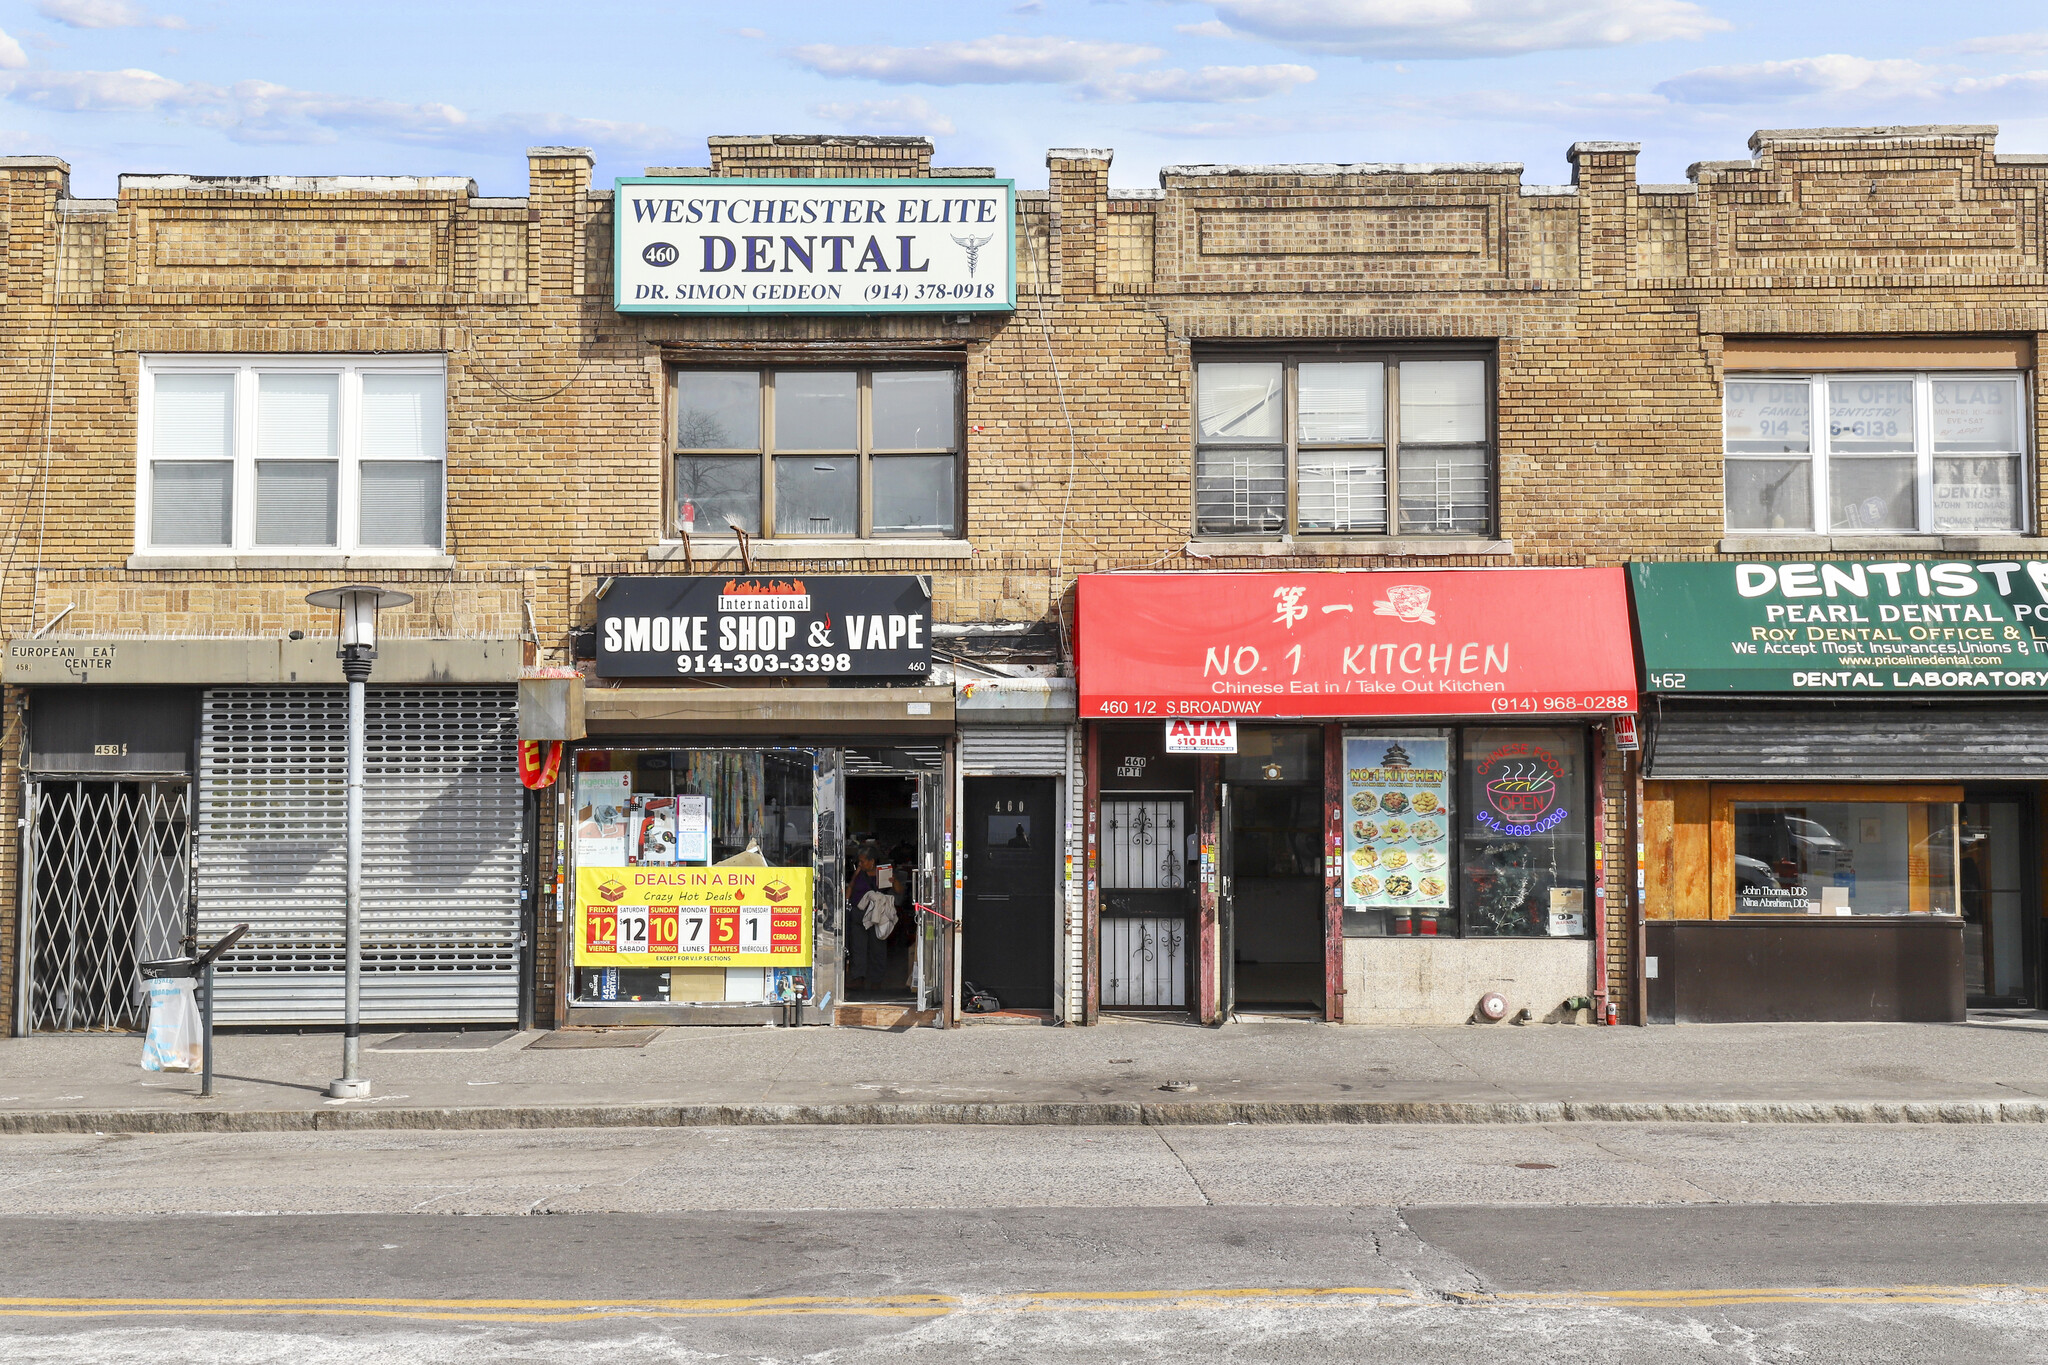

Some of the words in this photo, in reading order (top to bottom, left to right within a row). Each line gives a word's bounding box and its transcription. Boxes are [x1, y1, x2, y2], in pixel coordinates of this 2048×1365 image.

[632, 198, 886, 224] WESTCHESTER
[895, 198, 998, 223] ELITE
[645, 246, 676, 263] 460
[700, 235, 930, 273] DENTAL
[635, 284, 670, 300] DR.
[675, 284, 746, 300] SIMON
[753, 284, 842, 300] GEDEON
[863, 284, 909, 302] (914)
[914, 283, 995, 300] 378-0918
[1955, 385, 2002, 404] LAB
[1760, 420, 1789, 435] 914
[720, 597, 809, 610] International
[1766, 605, 1869, 623] PEARL
[1880, 605, 2003, 623] DENTAL
[604, 617, 707, 652] SMOKE
[719, 616, 795, 651] SHOP
[807, 620, 835, 647] &
[845, 615, 924, 650] VAPE
[1752, 627, 1796, 640] ROY
[1807, 627, 1901, 641] DENTAL
[1909, 626, 1995, 640] OFFICE
[2003, 626, 2020, 640] &
[12, 648, 75, 656] EUROPEAN
[93, 648, 116, 656] EAT
[65, 659, 112, 668] CENTER
[677, 654, 851, 673] 914-303-3398
[908, 662, 926, 672] 460
[1203, 646, 1268, 678] NO.
[1285, 644, 1302, 675] 1
[1342, 643, 1510, 675] KITCHEN
[1839, 655, 2002, 665] www.pricelinedental.com
[1651, 674, 1686, 688] 462
[1792, 671, 1885, 687] DENTAL
[1212, 681, 1283, 695] Chinese
[1290, 682, 1317, 694] Eat
[1324, 681, 1340, 693] in
[1345, 681, 1352, 694] /
[1359, 680, 1396, 693] Take
[1402, 680, 1434, 692] Out
[1439, 680, 1505, 693] Kitchen
[1100, 701, 1129, 714] 460
[1135, 701, 1157, 714] 1/2
[1167, 700, 1262, 714] S.BROADWAY
[1491, 697, 1538, 712] (914)
[1544, 696, 1628, 709] 968-0288
[1170, 720, 1231, 737] ATM
[1615, 716, 1634, 734] ATM
[96, 745, 118, 754] 458
[1126, 757, 1145, 766] 460
[1477, 743, 1529, 776] CHINESE
[1533, 746, 1565, 779] FOOD
[579, 777, 619, 787] ingenuity
[1384, 769, 1442, 782] KITCHEN
[995, 801, 1024, 812] 460
[1500, 795, 1543, 810] OPEN
[1476, 807, 1568, 836] 914-968-0288
[635, 874, 686, 885] DEALS
[692, 874, 706, 885] IN
[712, 874, 723, 885] A
[730, 874, 755, 885] BIN
[644, 892, 673, 901] Crazy
[680, 892, 699, 900] Hot
[706, 892, 732, 900] Deals
[1743, 886, 1760, 895] John
[1791, 887, 1807, 895] DDS
[1743, 898, 1757, 907] Nina
[1793, 899, 1809, 908] DDS
[589, 917, 616, 941] $12
[620, 918, 646, 941] $12
[650, 917, 678, 942] $10
[686, 918, 703, 941] $7
[716, 917, 734, 941] $5
[746, 918, 757, 940] $1
